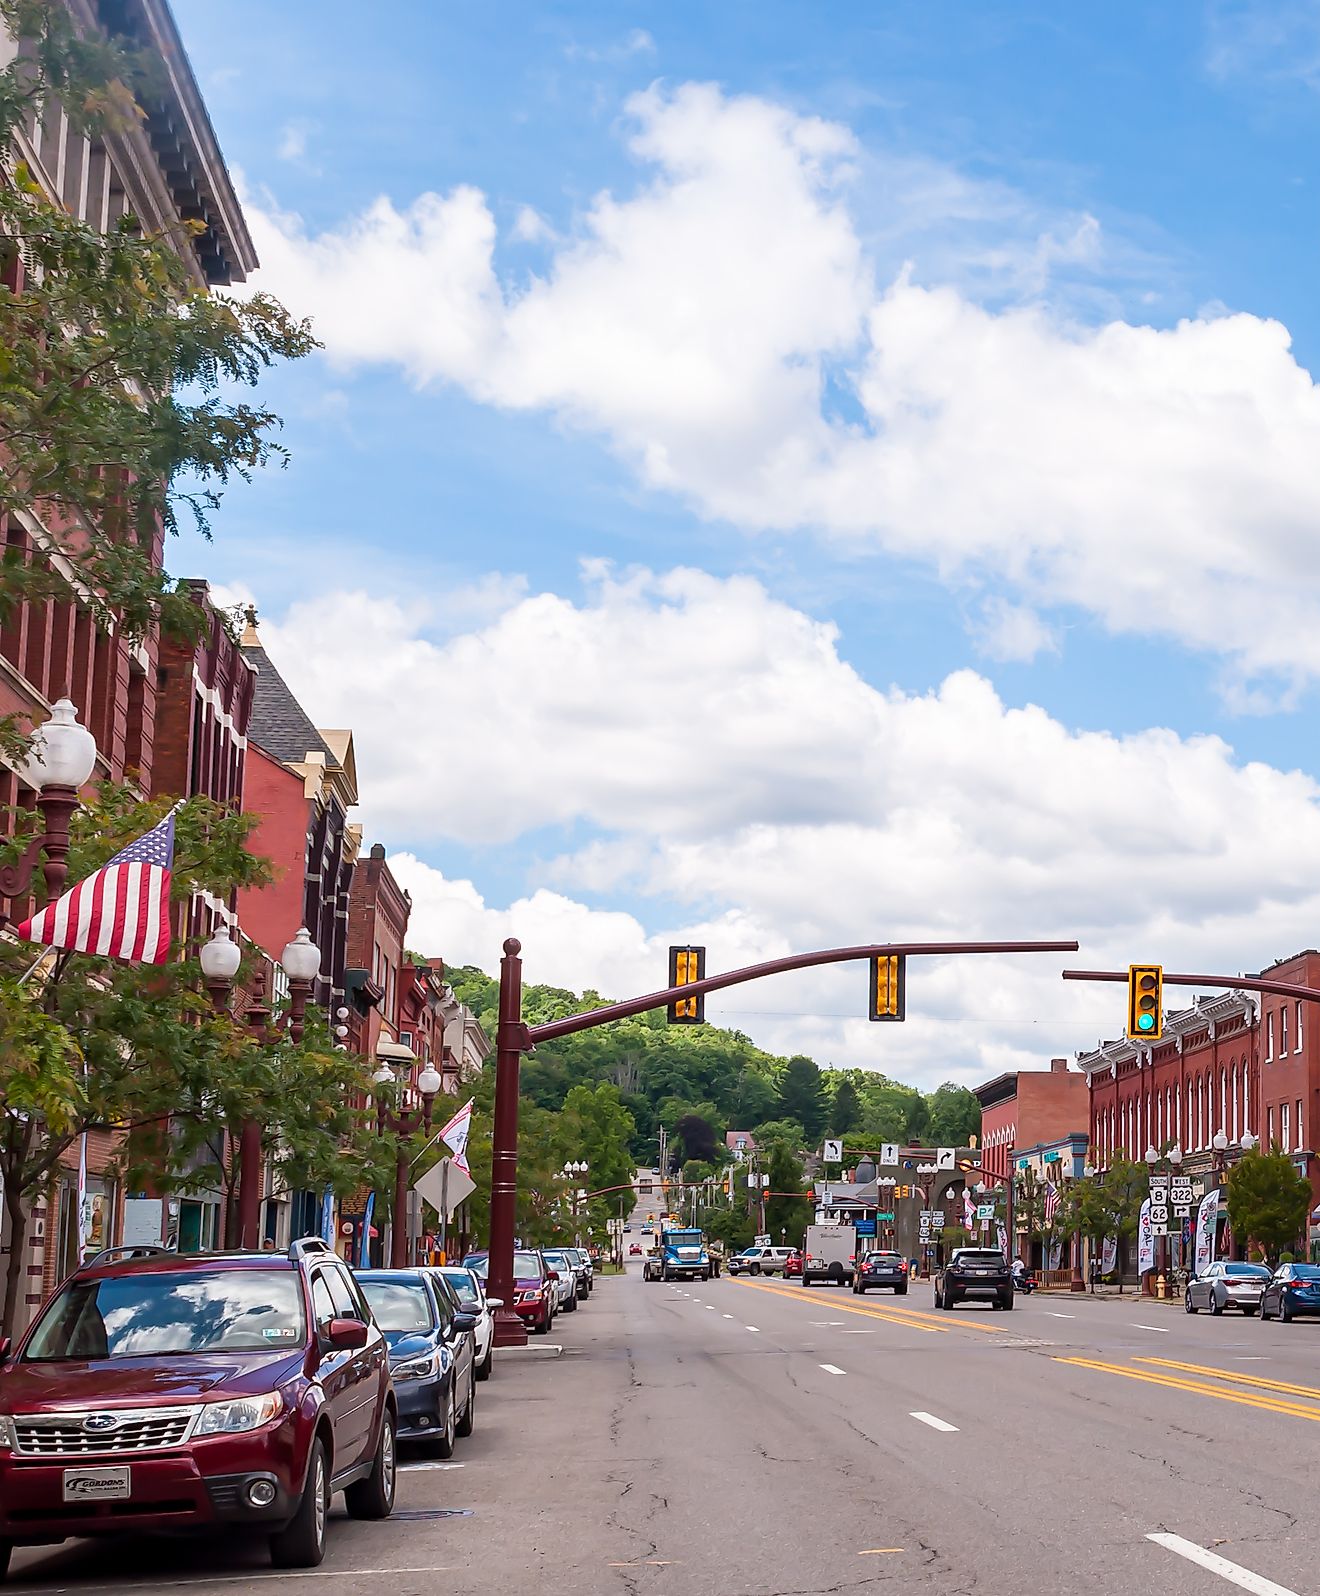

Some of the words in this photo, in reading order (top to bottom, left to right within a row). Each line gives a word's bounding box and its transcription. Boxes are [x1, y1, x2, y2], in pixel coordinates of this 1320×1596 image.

[1154, 1191, 1163, 1201] 8
[1172, 1190, 1191, 1200] 322
[1152, 1209, 1166, 1219] 62
